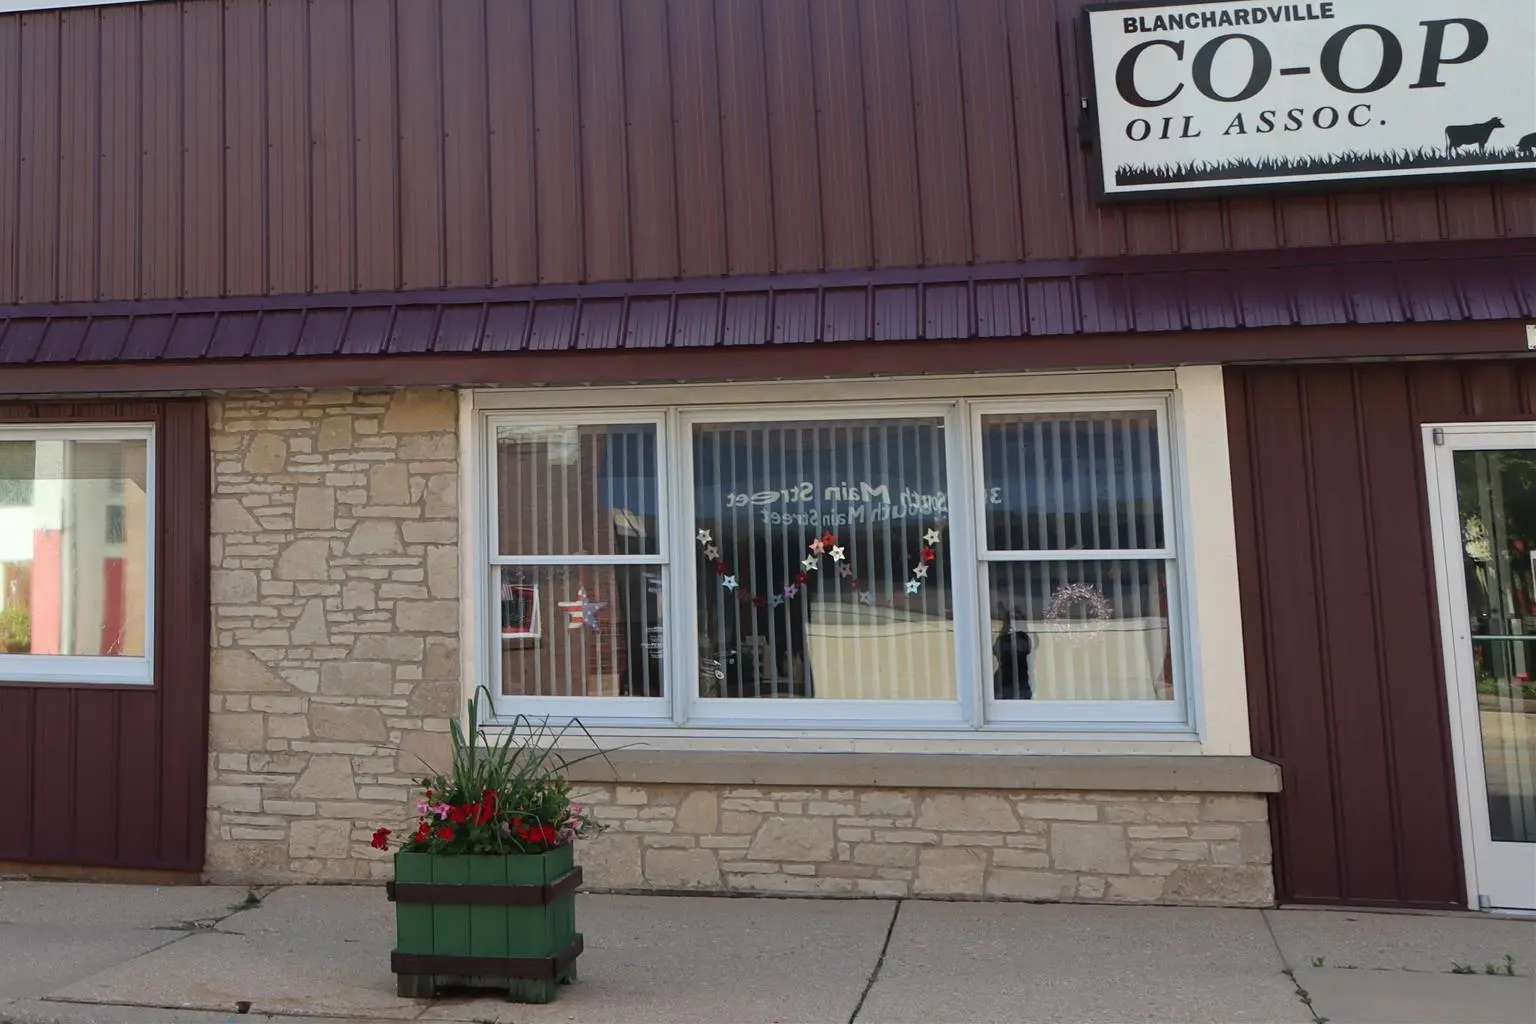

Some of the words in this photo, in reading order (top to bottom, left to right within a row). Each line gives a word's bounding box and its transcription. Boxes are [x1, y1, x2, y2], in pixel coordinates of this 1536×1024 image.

[1123, 2, 1335, 34] BLANCHARDVILLE
[1114, 17, 1490, 108] CO-OP
[1125, 115, 1202, 142] OIL
[1223, 104, 1387, 136] ASSOC.
